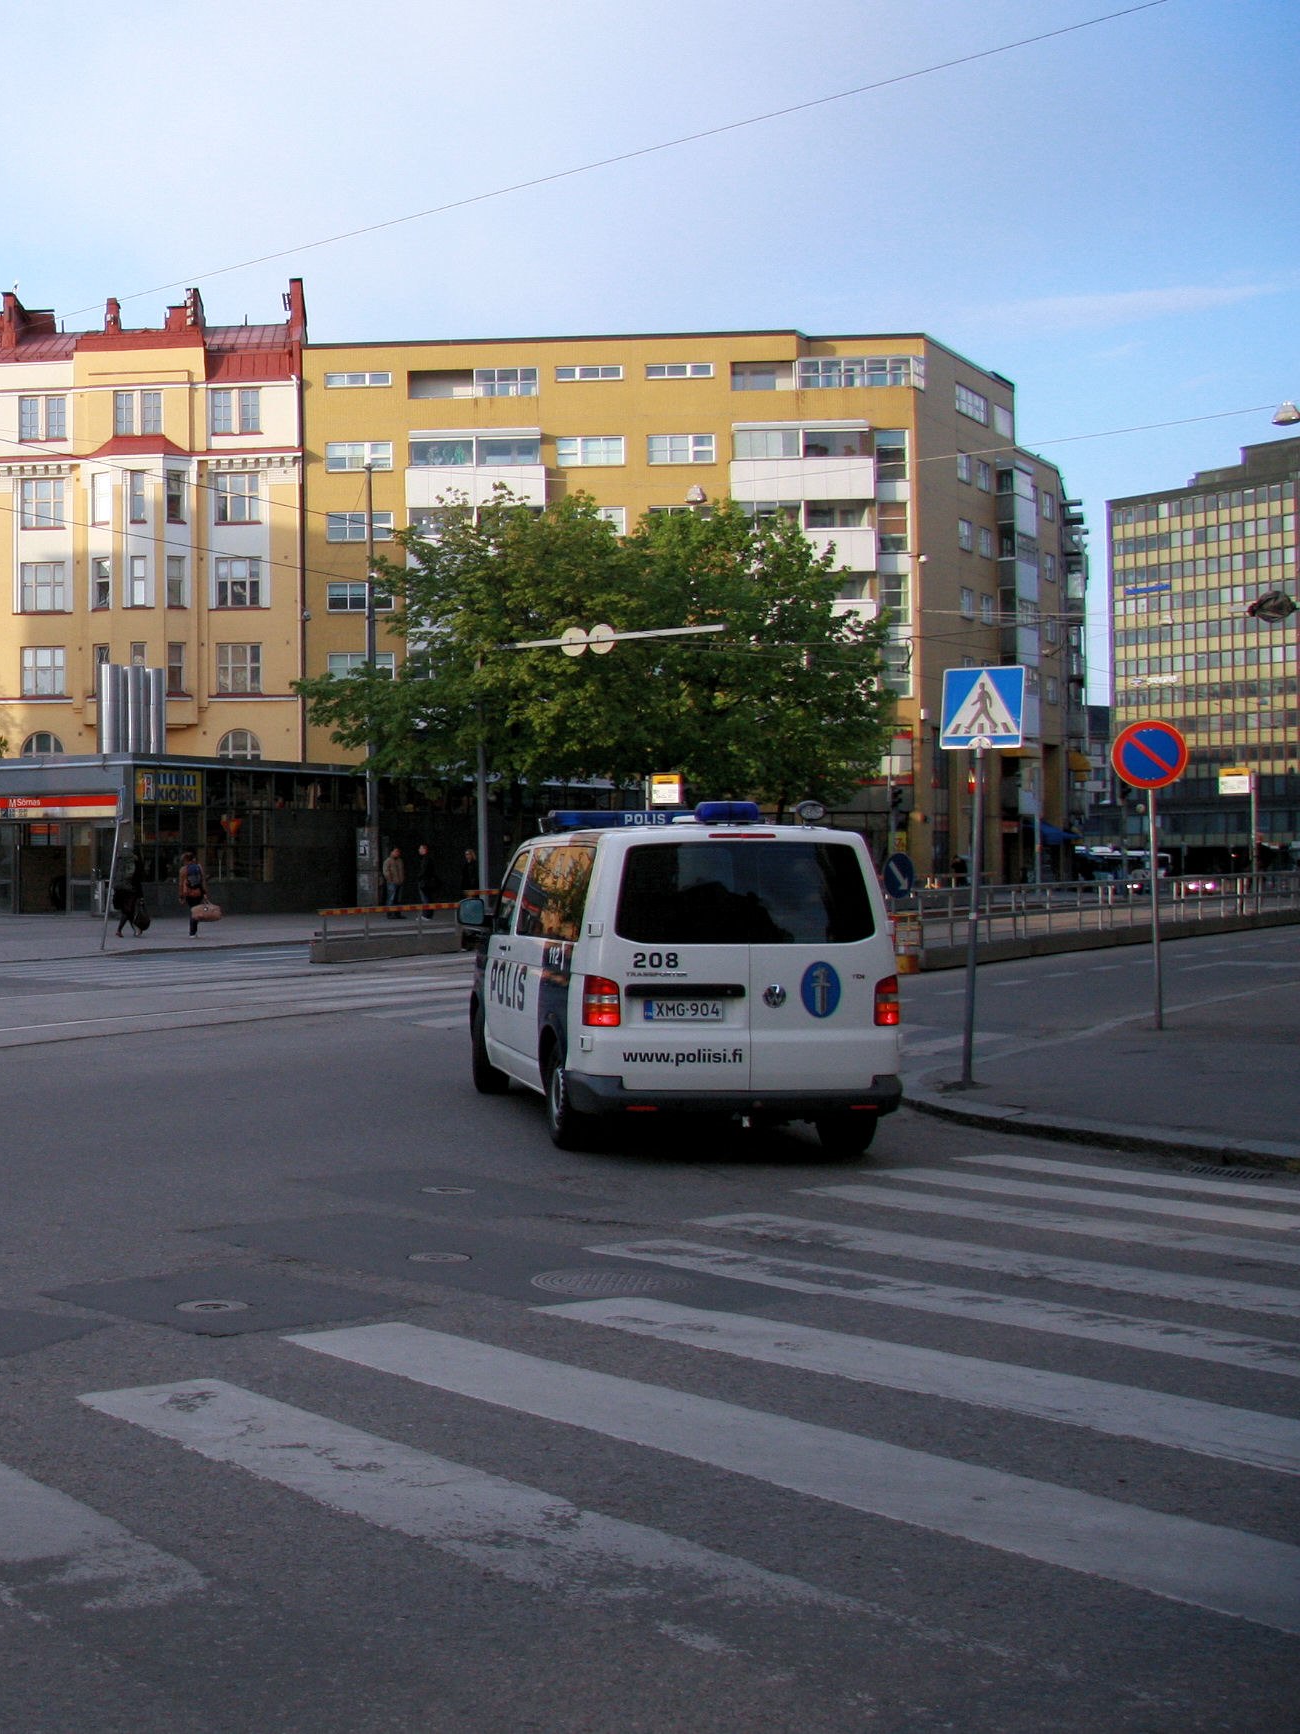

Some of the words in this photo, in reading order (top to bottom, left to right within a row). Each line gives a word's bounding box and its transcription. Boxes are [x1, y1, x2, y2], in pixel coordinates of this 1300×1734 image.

[155, 788, 196, 802] KIOSKI
[624, 813, 666, 825] POLIS
[548, 946, 561, 965] 112
[633, 952, 679, 969] 208
[490, 960, 528, 1011] POLIS
[655, 1002, 720, 1017] XMG-904
[622, 1048, 743, 1067] www.poliisi.fi
